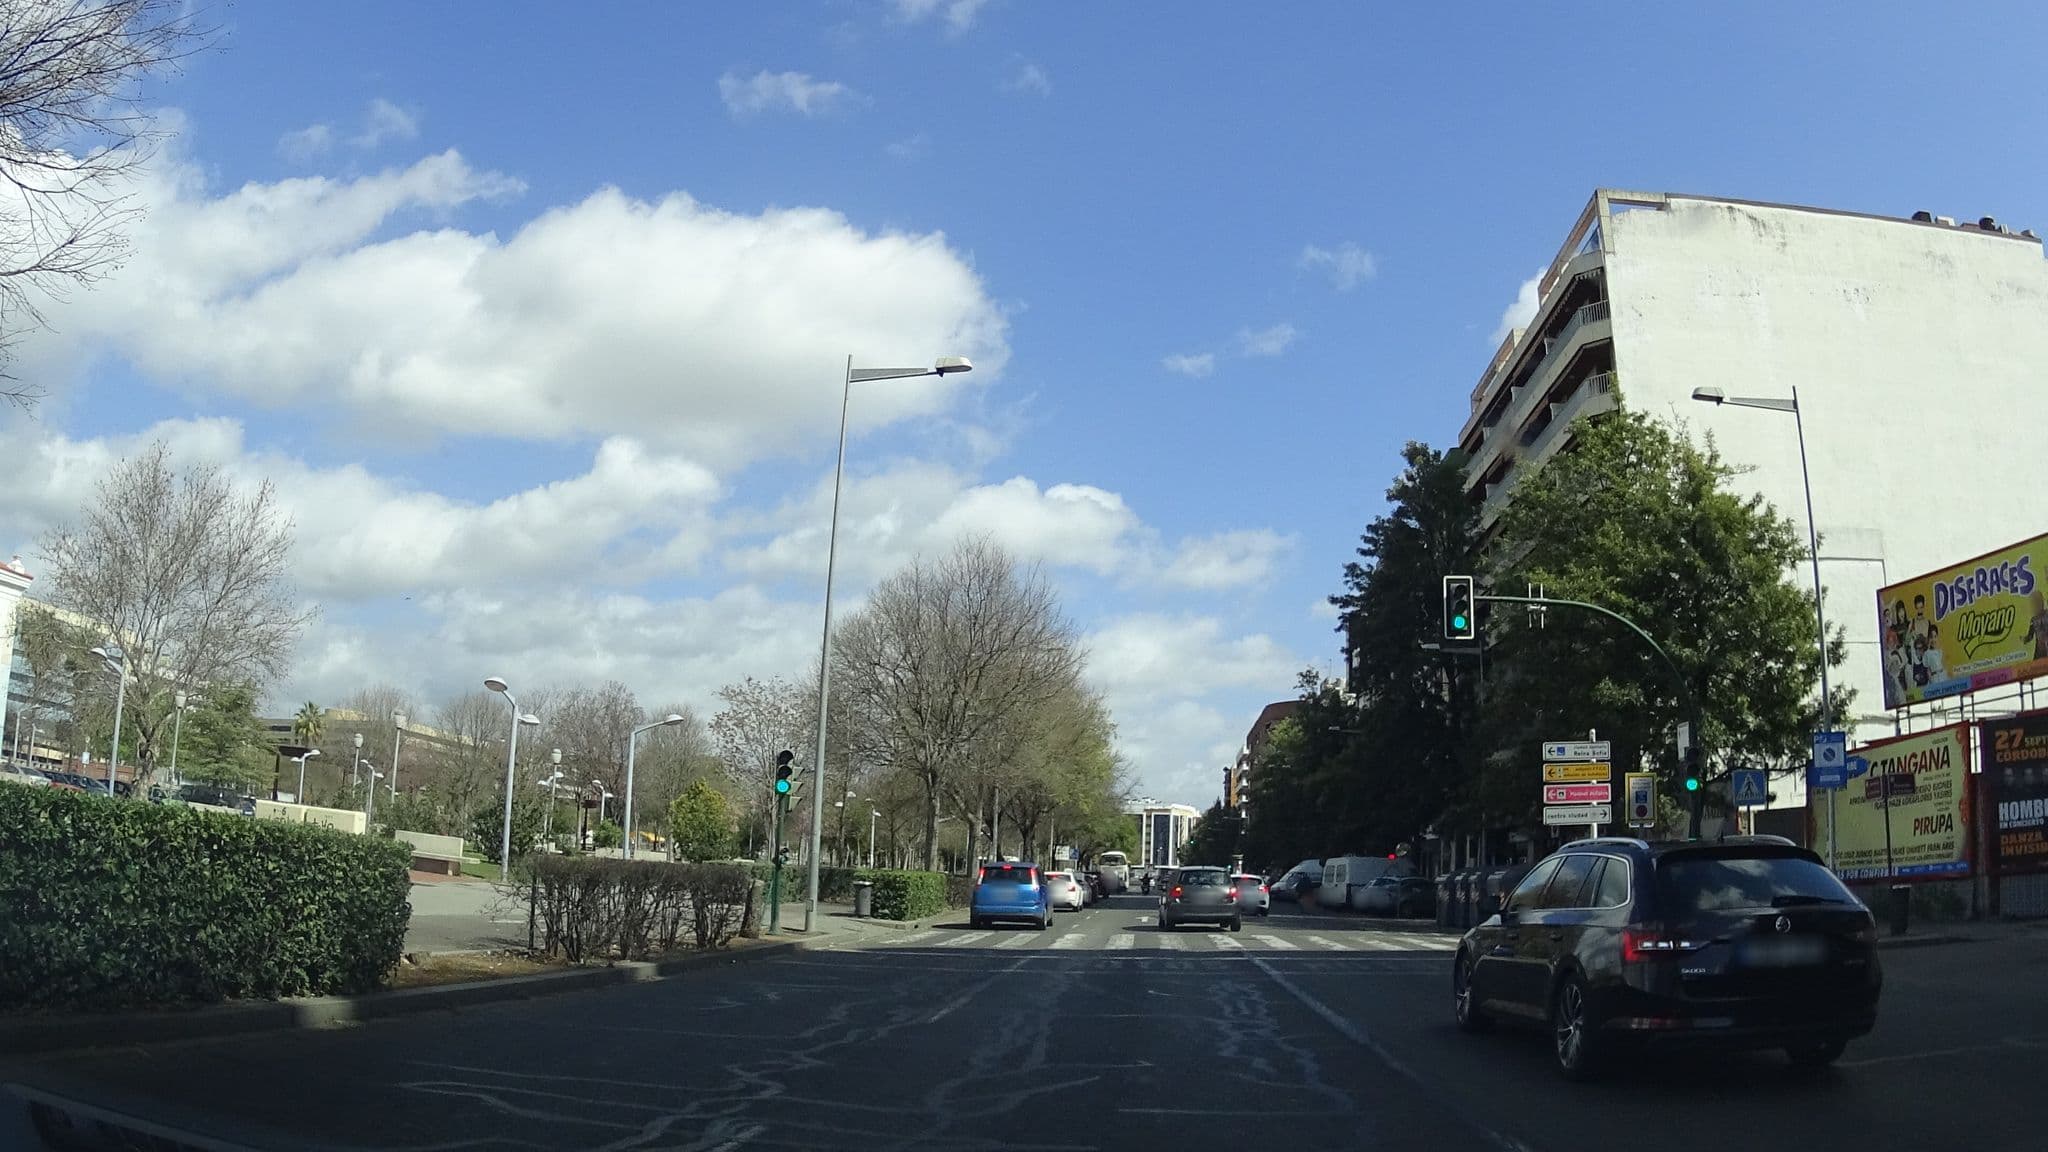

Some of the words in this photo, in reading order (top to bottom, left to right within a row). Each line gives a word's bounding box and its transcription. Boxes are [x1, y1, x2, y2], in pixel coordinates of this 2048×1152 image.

[1934, 556, 2034, 621] DISFRACES
[1958, 605, 2015, 642] Moyano
[1995, 728, 2025, 749] 27
[1997, 748, 2048, 762] CORDOB
[1913, 812, 1954, 837] PIRUPA
